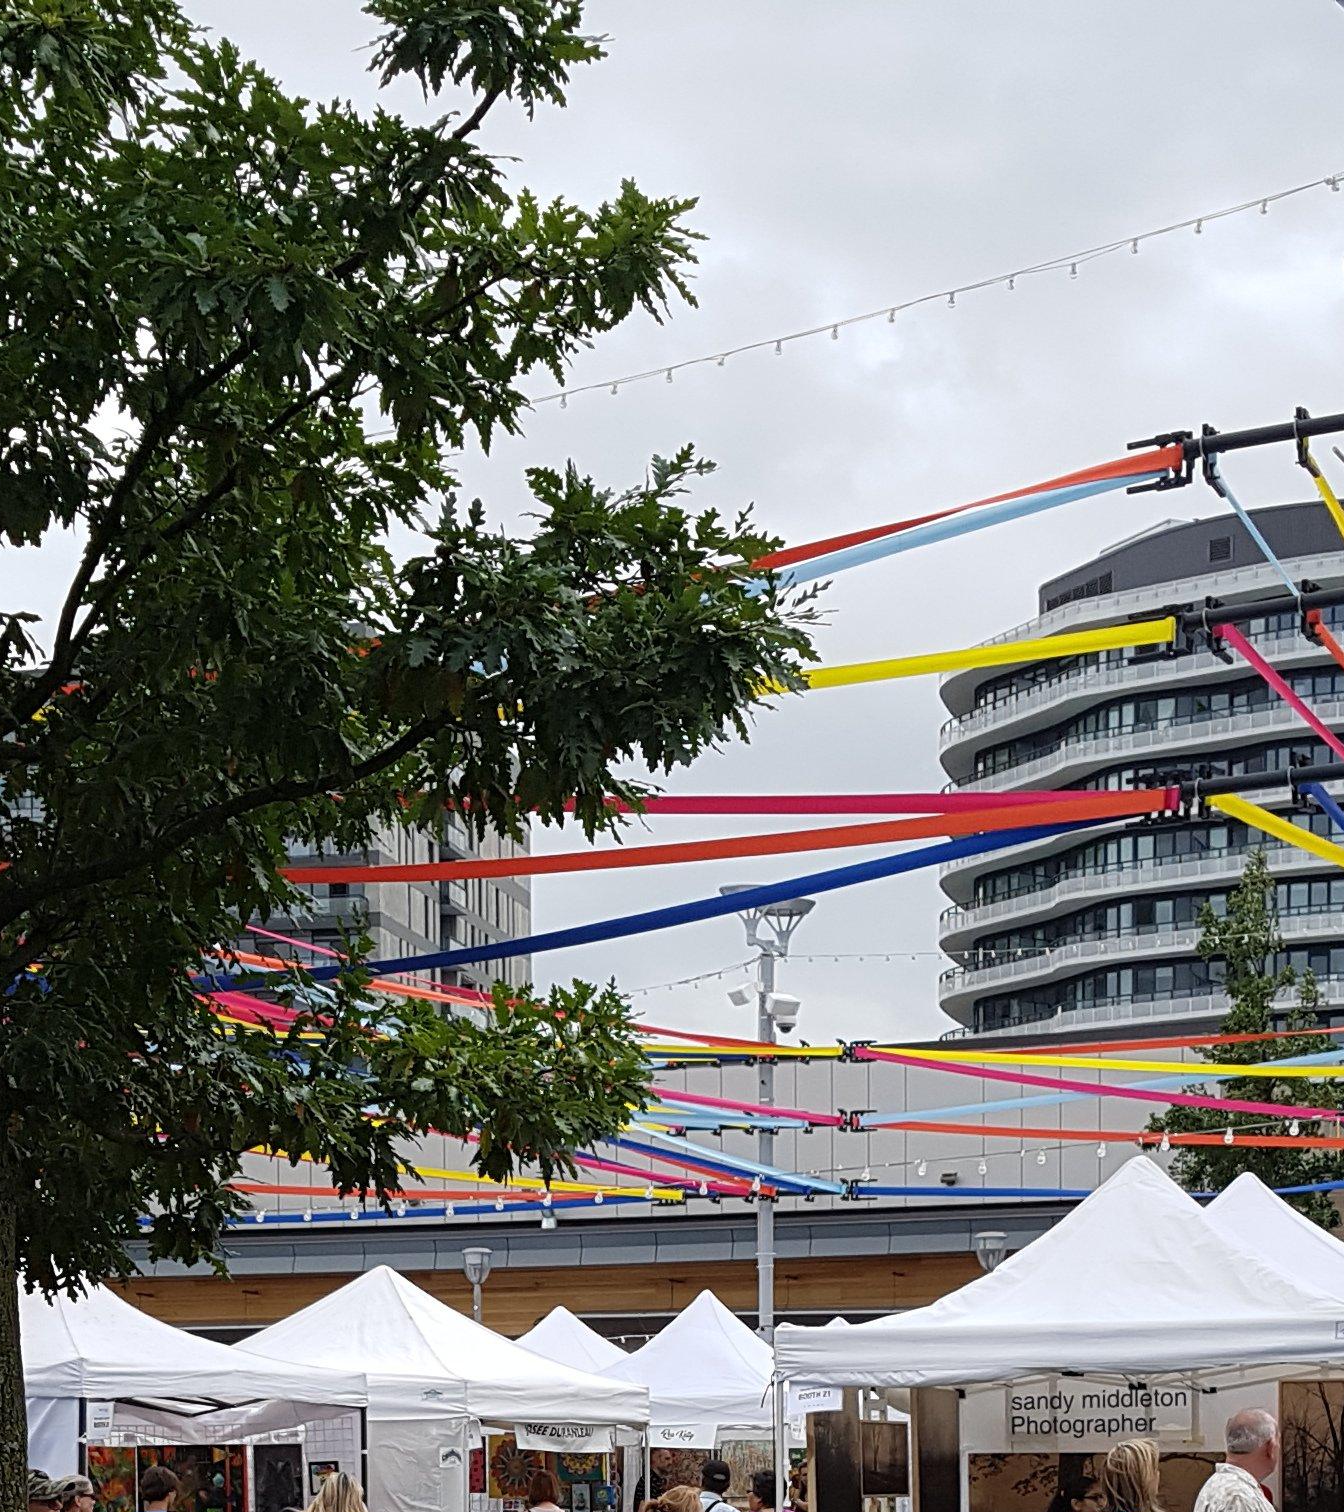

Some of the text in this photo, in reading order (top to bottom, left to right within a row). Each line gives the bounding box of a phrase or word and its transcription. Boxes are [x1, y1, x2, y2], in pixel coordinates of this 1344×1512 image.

[1011, 1389, 1187, 1414] sandy middleton
[1011, 1414, 1156, 1438] Photographer
